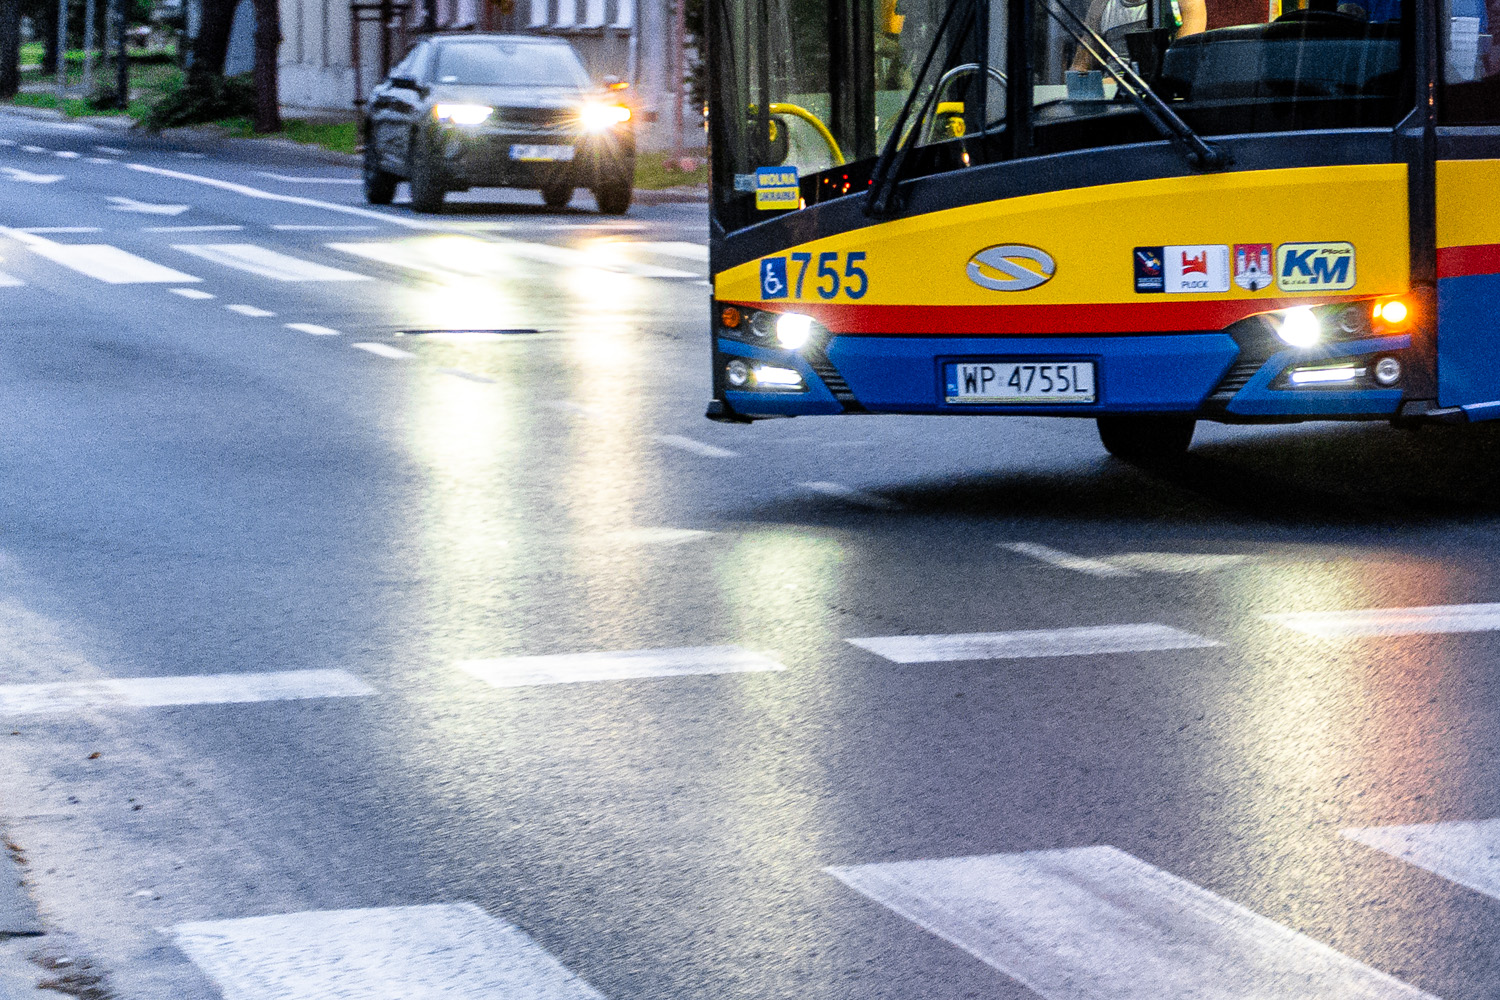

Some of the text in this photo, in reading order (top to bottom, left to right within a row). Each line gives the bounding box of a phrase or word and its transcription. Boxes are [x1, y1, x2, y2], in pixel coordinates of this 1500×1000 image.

[758, 173, 796, 186] WOLNA
[791, 251, 869, 300] 755
[1282, 249, 1352, 285] KM
[962, 365, 1089, 394] WP 4755L
